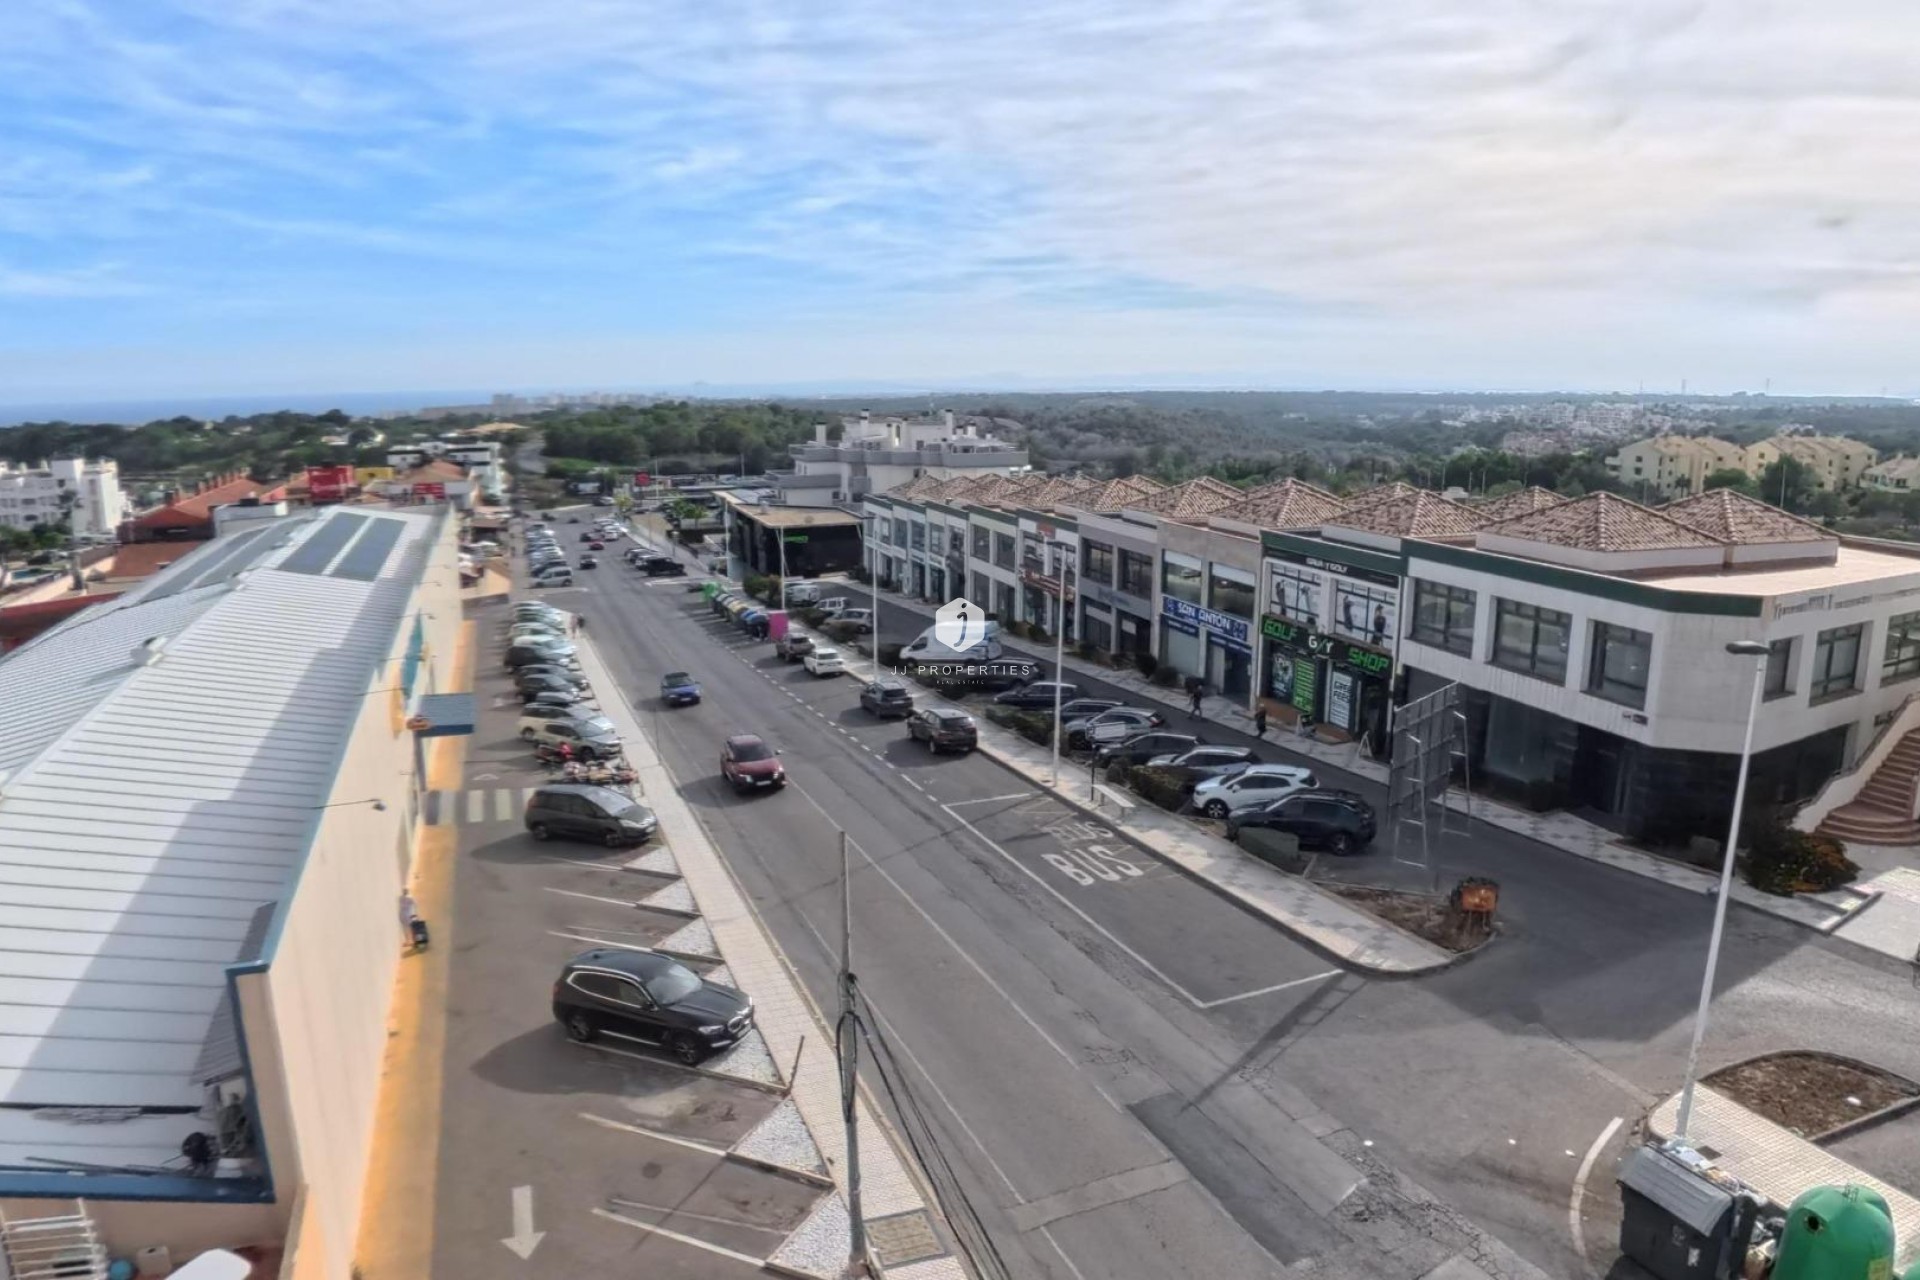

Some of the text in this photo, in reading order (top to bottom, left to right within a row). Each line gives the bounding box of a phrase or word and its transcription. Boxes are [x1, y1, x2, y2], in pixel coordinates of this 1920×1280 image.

[1263, 620, 1297, 641] GOLF
[1348, 647, 1389, 672] SHOP
[1041, 845, 1144, 886] BUS
